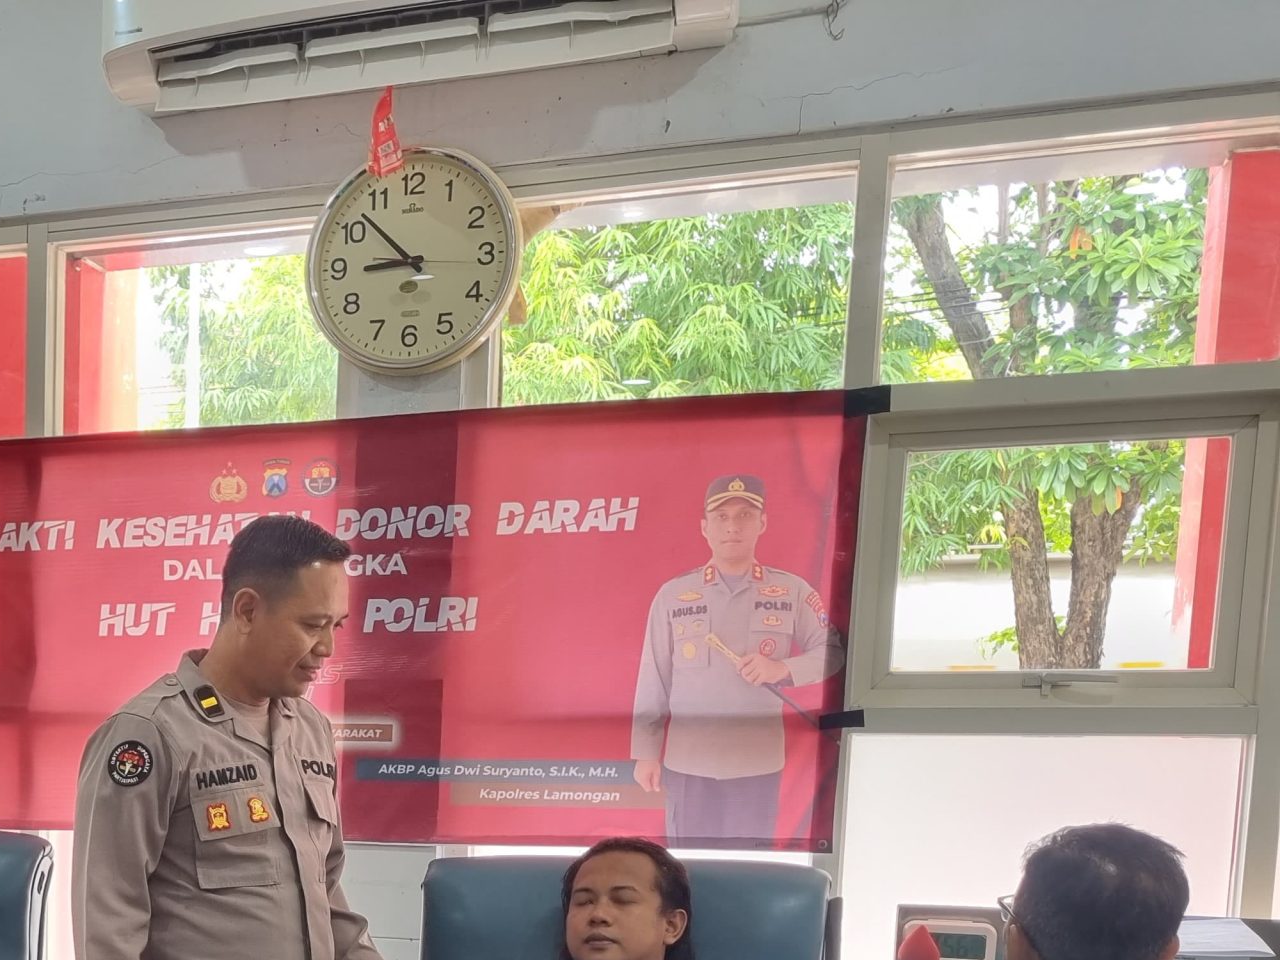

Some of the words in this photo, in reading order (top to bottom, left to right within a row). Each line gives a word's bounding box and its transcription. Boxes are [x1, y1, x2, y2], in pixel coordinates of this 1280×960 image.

[401, 172, 425, 196] 12
[444, 179, 454, 202] 1
[368, 187, 389, 211] 11
[467, 206, 486, 229] 2
[341, 220, 366, 245] 10
[477, 242, 495, 266] 3
[330, 257, 347, 280] 9
[465, 280, 484, 303] 4
[343, 292, 360, 315] 8
[369, 319, 386, 341] 7
[436, 312, 454, 335] 5
[400, 324, 418, 347] 6
[96, 510, 310, 549] KESEHAT
[335, 504, 472, 541] DONOR
[496, 497, 640, 535] DARAH
[163, 559, 223, 581] DAL
[343, 553, 408, 577] GKA
[98, 602, 176, 637] HUT
[363, 596, 479, 633] POLRI
[754, 601, 793, 612] POLRI
[196, 763, 258, 790] HAMZAID
[378, 764, 415, 774] AKBP
[417, 764, 451, 777] Agus
[454, 765, 480, 776] Dwi
[483, 766, 546, 778] Suryanto,
[588, 767, 619, 777] M.H.
[479, 788, 540, 801] Kapolres
[543, 789, 620, 803] Lamongan
